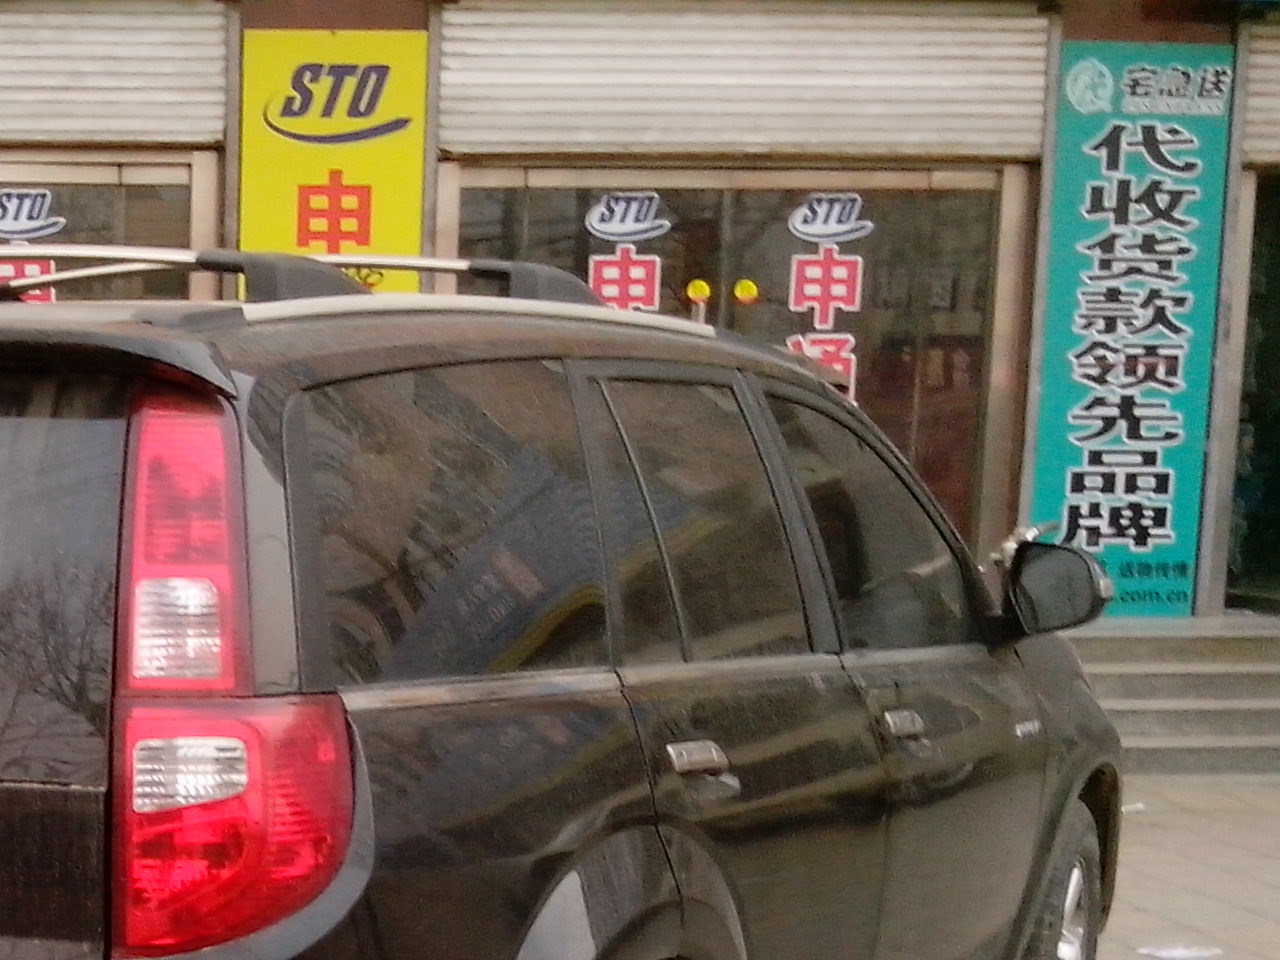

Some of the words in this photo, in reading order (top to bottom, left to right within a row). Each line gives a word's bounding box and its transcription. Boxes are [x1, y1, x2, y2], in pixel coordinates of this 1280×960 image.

[280, 62, 391, 119] STO
[295, 168, 373, 255] 申
[598, 195, 656, 224] STO
[801, 197, 861, 225] STO
[590, 245, 660, 311] 申
[1058, 120, 1200, 551] 代收货款领先品牌
